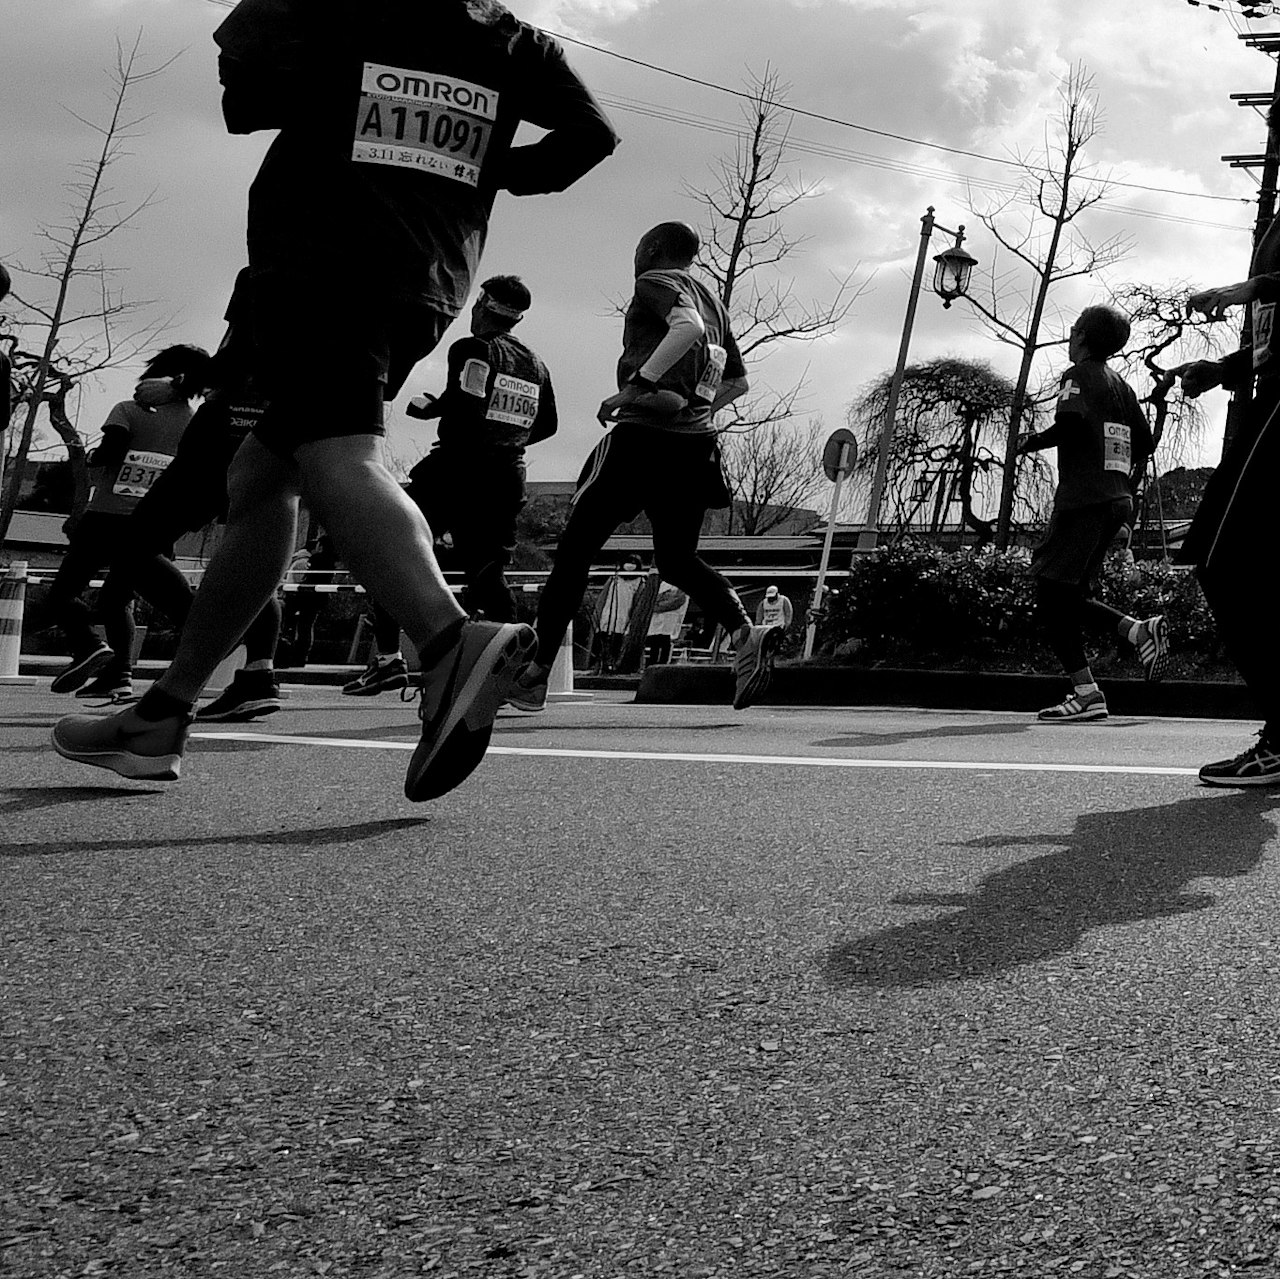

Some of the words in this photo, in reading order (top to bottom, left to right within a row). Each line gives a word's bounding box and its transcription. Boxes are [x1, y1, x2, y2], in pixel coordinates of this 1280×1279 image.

[376, 73, 488, 114] OMRON
[360, 101, 483, 160] A11091
[368, 147, 394, 161] 3.11
[499, 377, 536, 396] OMRON
[490, 391, 536, 417] A11506
